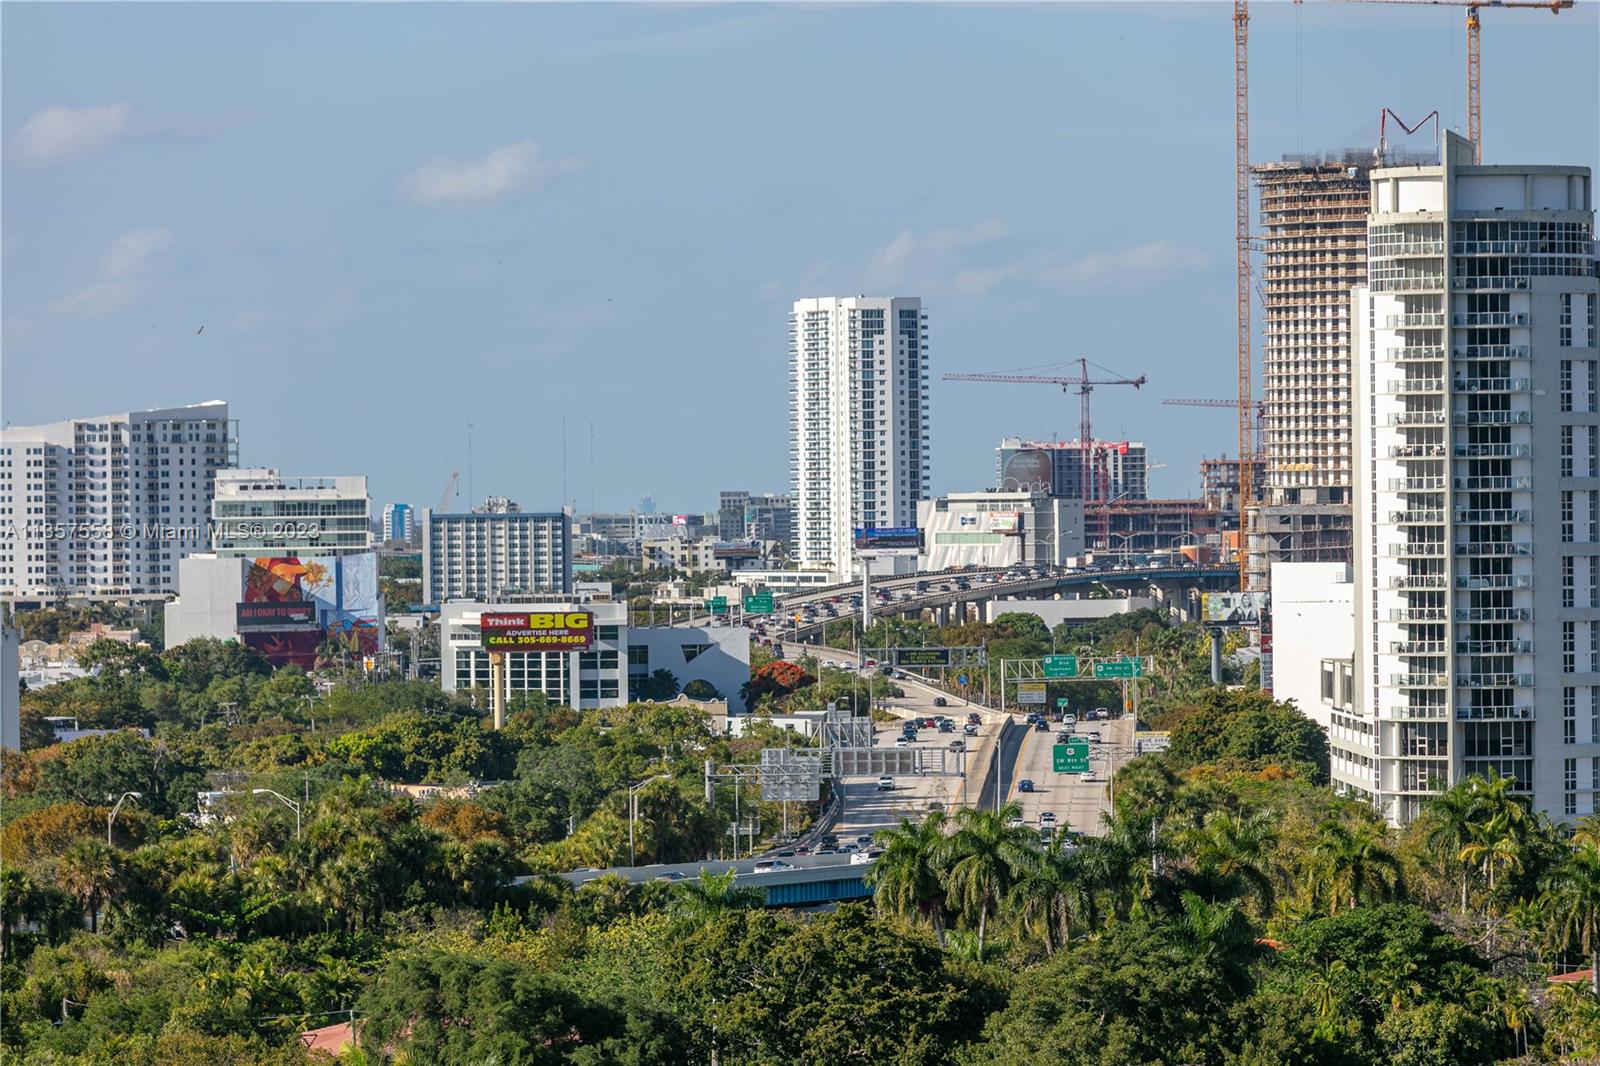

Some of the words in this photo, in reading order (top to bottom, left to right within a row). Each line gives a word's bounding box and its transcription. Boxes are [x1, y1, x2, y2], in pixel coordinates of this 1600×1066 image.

[241, 607, 253, 617] AM
[276, 607, 287, 616] TO
[487, 618, 525, 627] Think
[530, 613, 588, 629] BIG
